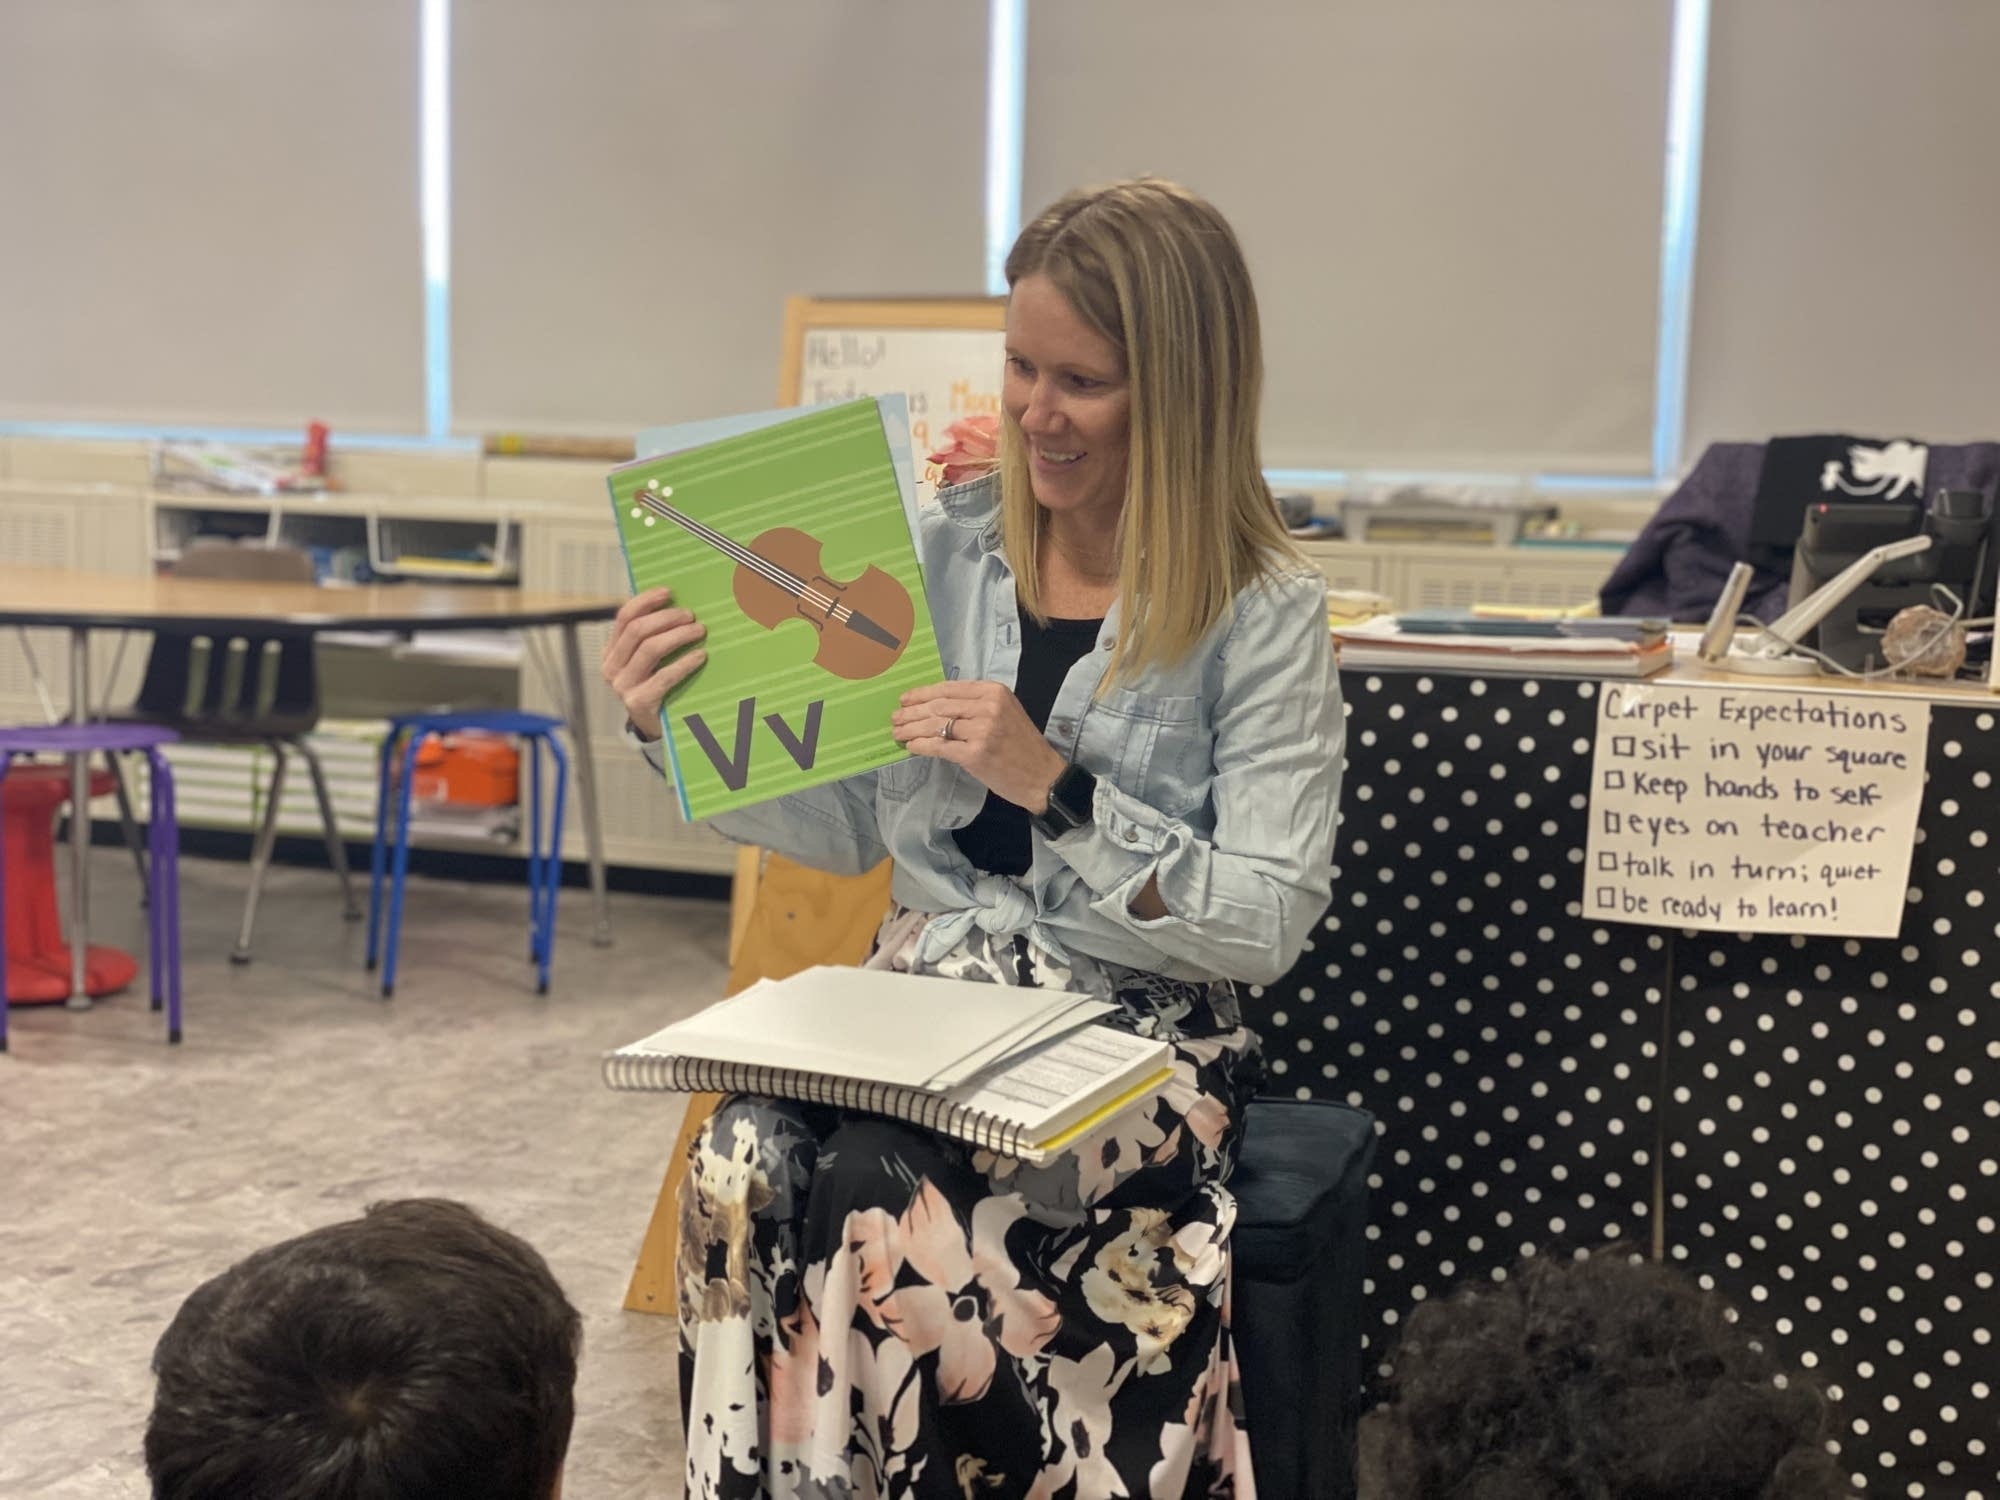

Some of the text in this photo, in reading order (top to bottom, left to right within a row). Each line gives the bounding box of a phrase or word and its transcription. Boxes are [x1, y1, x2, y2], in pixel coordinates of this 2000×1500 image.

[808, 335, 886, 369] Hello!
[1605, 689, 1907, 733] Carpet Expectations
[1642, 733, 1908, 774] sit in your square
[1705, 772, 1778, 800] hands
[1795, 778, 1820, 801] to
[1831, 783, 1882, 806] self
[1628, 813, 1885, 847] eyes on teacher
[1623, 851, 1675, 878] talk
[1690, 860, 1715, 881] in
[1820, 864, 1881, 888] quiet
[1622, 887, 1838, 923] be ready to learn!
